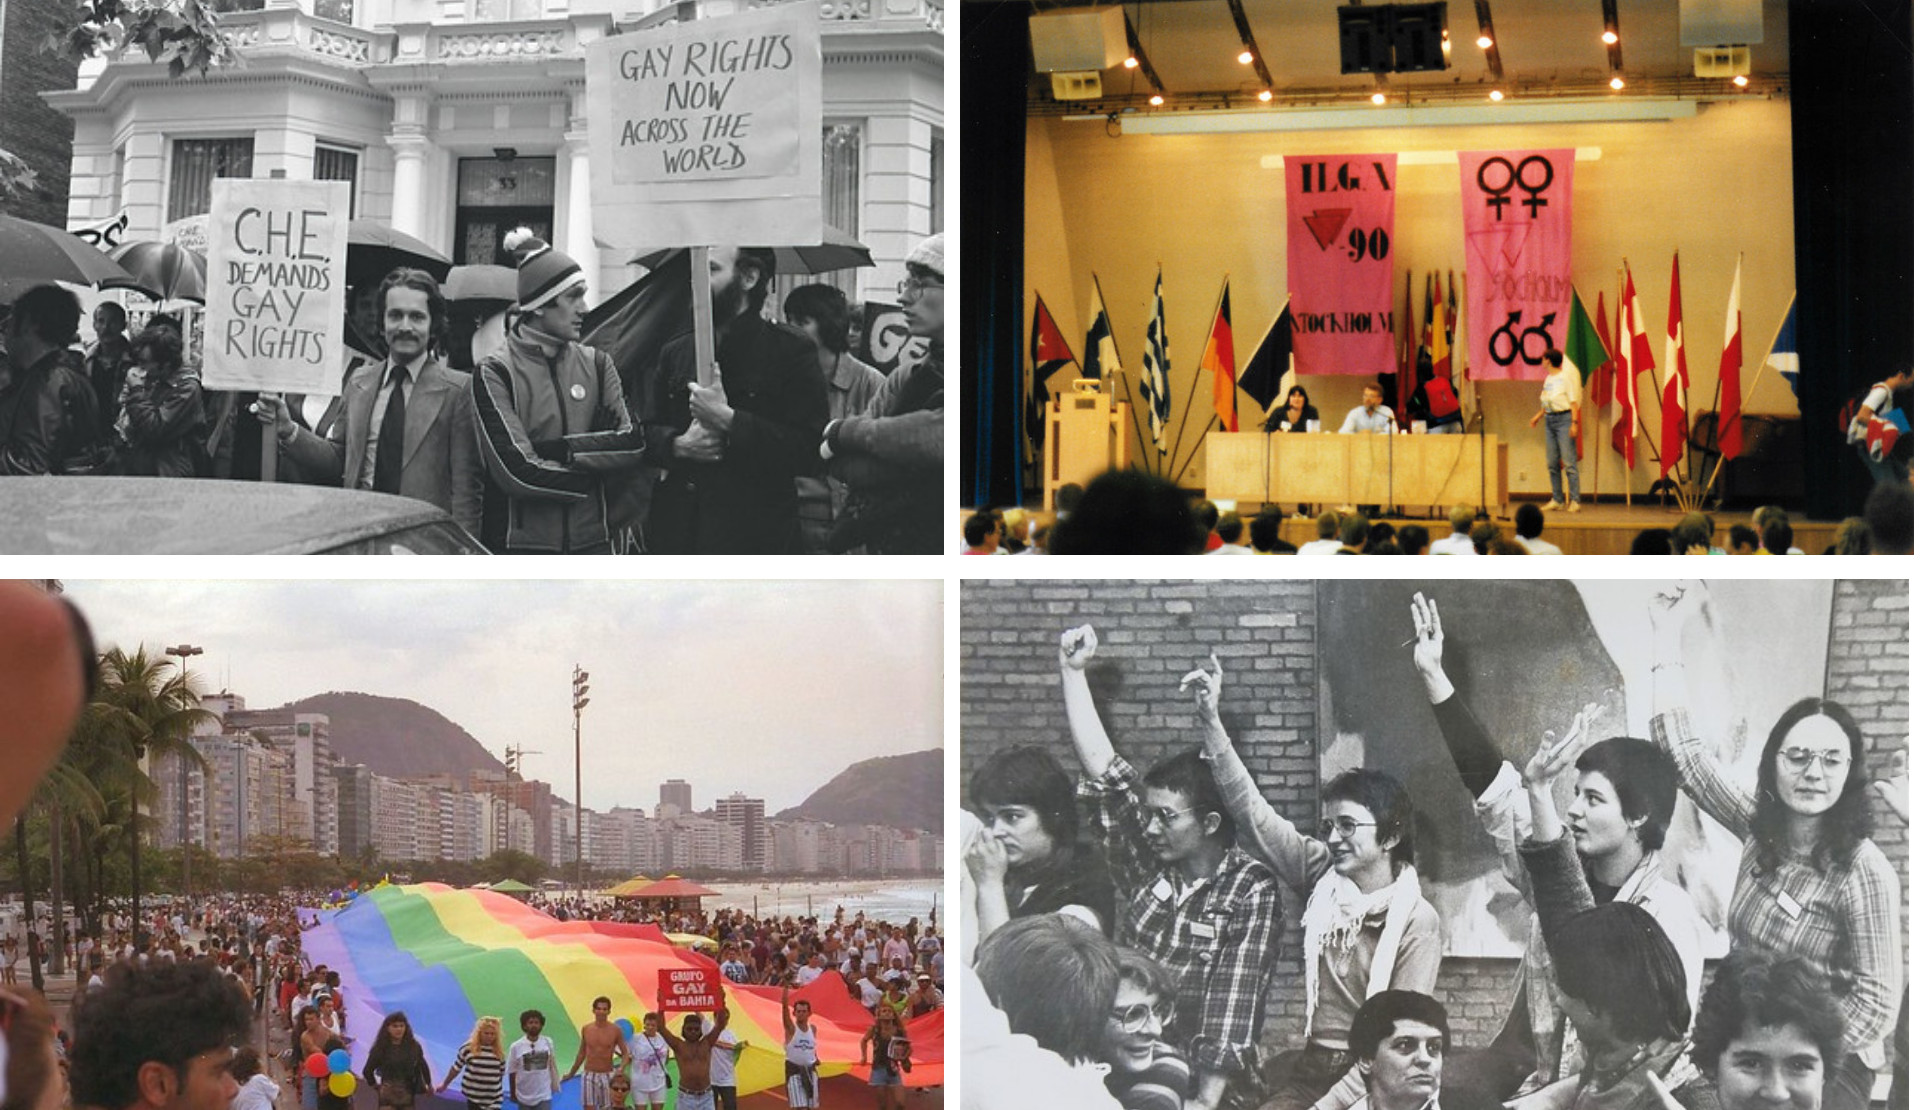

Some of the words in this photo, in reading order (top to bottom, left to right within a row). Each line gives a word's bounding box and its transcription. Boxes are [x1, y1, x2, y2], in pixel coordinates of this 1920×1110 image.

[620, 48, 673, 81] GAY
[683, 33, 794, 78] RIGHTS
[665, 76, 736, 112] NOW
[620, 117, 689, 146] ACROSS
[701, 112, 753, 141] THE
[663, 142, 747, 175] WORLD
[234, 207, 332, 264] C.H.E.
[227, 260, 332, 291] DEMANDS
[231, 286, 306, 320] GAY
[225, 319, 327, 365] RIGHTS
[670, 970, 704, 982] GRUPO
[672, 982, 706, 995] GAY
[679, 995, 715, 1006] BAHIA
